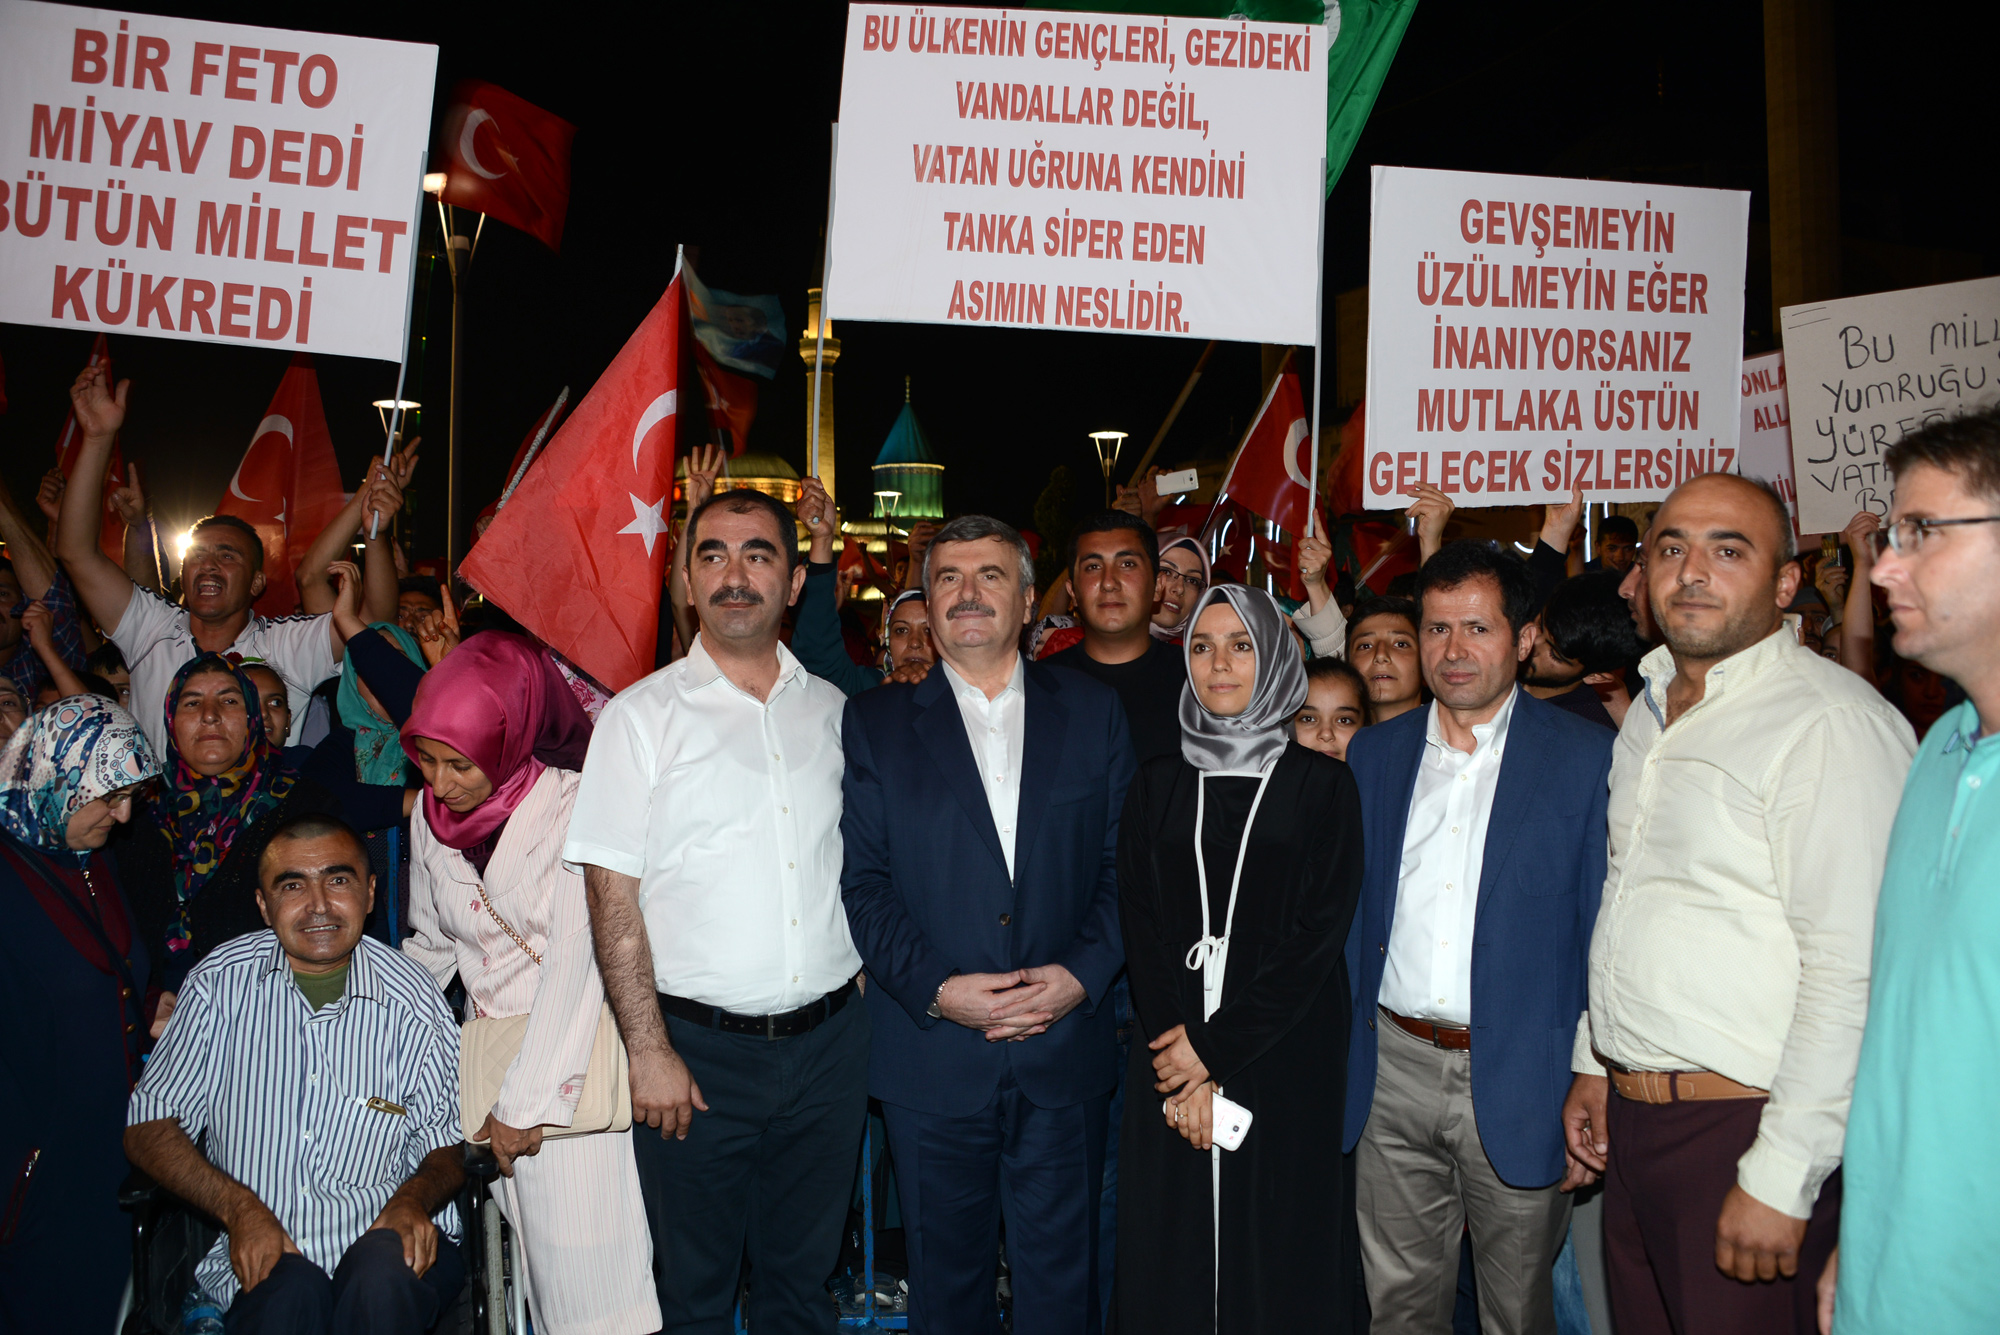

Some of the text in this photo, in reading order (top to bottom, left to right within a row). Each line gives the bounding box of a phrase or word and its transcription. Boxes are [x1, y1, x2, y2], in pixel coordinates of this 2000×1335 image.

[72, 20, 337, 108] BİR FETO
[864, 7, 1310, 73] BU ÜLKENİN GENÇLERİ, GEZİDEKİ
[957, 81, 1208, 140] VANDALLAR DEĞİL,
[27, 93, 363, 190] MİYAV DEDİ
[914, 140, 1244, 199] VATAN UĞRUNA KENDİNİ
[0, 168, 407, 273] BÜTÜN MİLLET
[944, 208, 1205, 264] TANKA SİPER EDEN
[1461, 199, 1674, 260] GEVŞEMEYİN
[52, 255, 315, 344] KÜKREDİ
[948, 280, 1189, 332] ASIMIN NESLİDİR.
[1418, 249, 1708, 314] ÜZÜLMEYİN EĞER
[1434, 312, 1691, 372] İNANIYORSANIZ
[1839, 325, 1895, 370] BU
[1418, 381, 1699, 432] MUTLAKA ÜSTÜN
[1822, 364, 1986, 413] YUMRUĞU
[1370, 439, 1737, 498] GELECEK SİZLERSİNİZ
